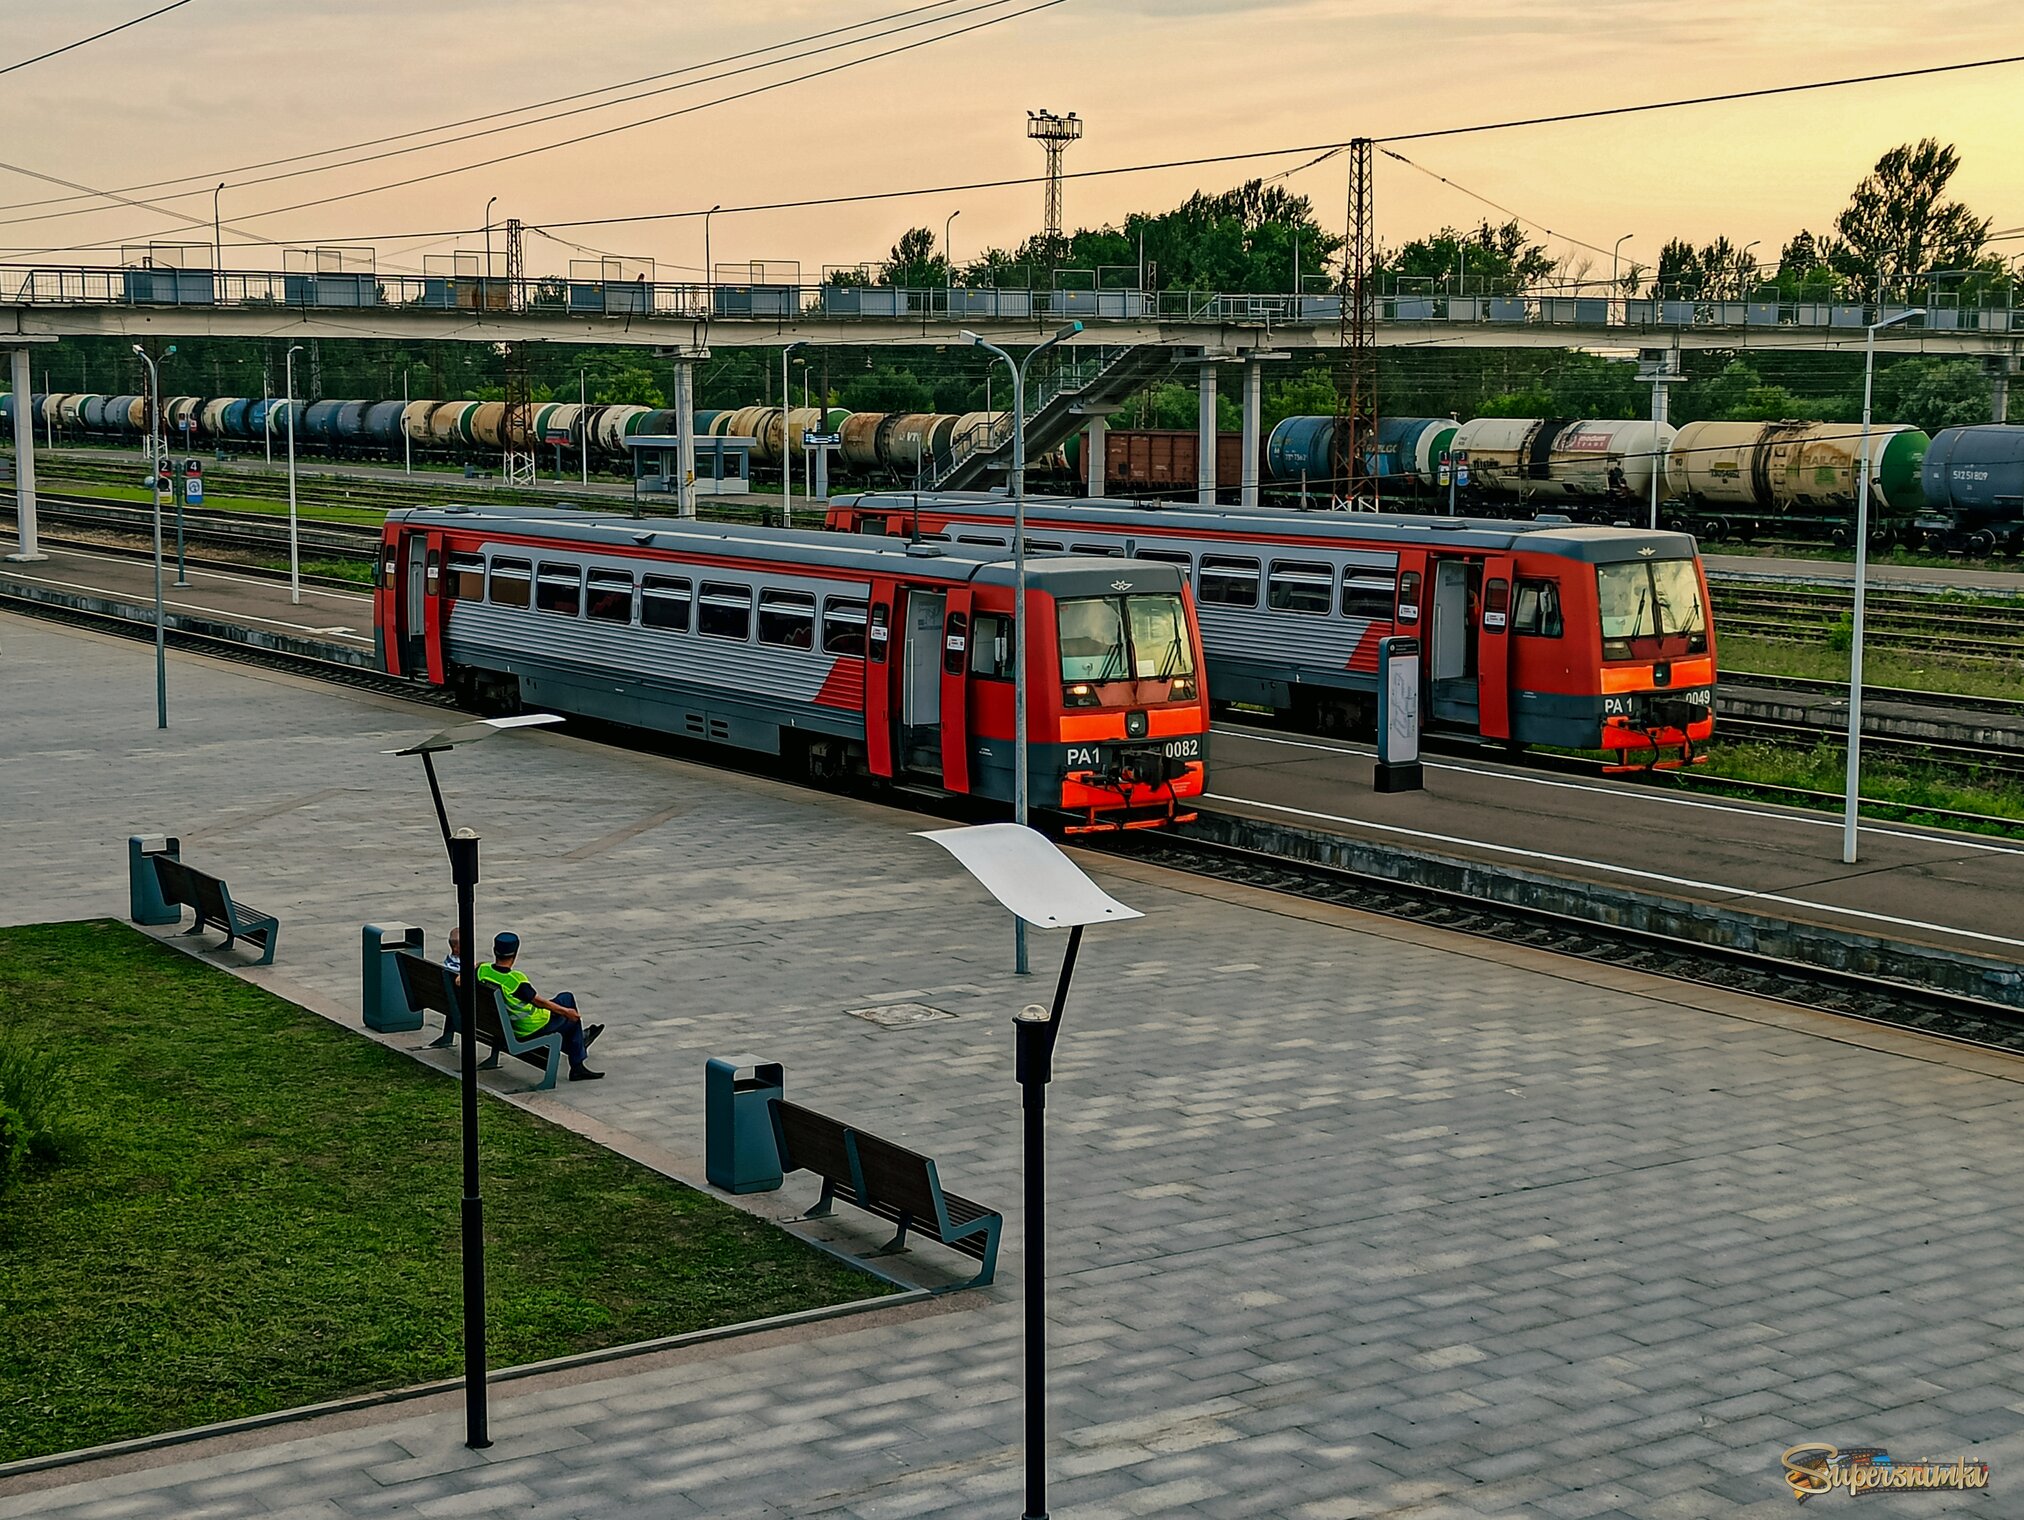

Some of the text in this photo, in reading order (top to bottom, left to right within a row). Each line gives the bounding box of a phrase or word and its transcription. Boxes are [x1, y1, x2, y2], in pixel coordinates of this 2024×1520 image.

[160, 461, 169, 472] 2
[190, 461, 198, 471] 4
[1953, 470, 1989, 481] 51251809
[1685, 689, 1711, 705] 0049
[1165, 739, 1199, 758] 0082
